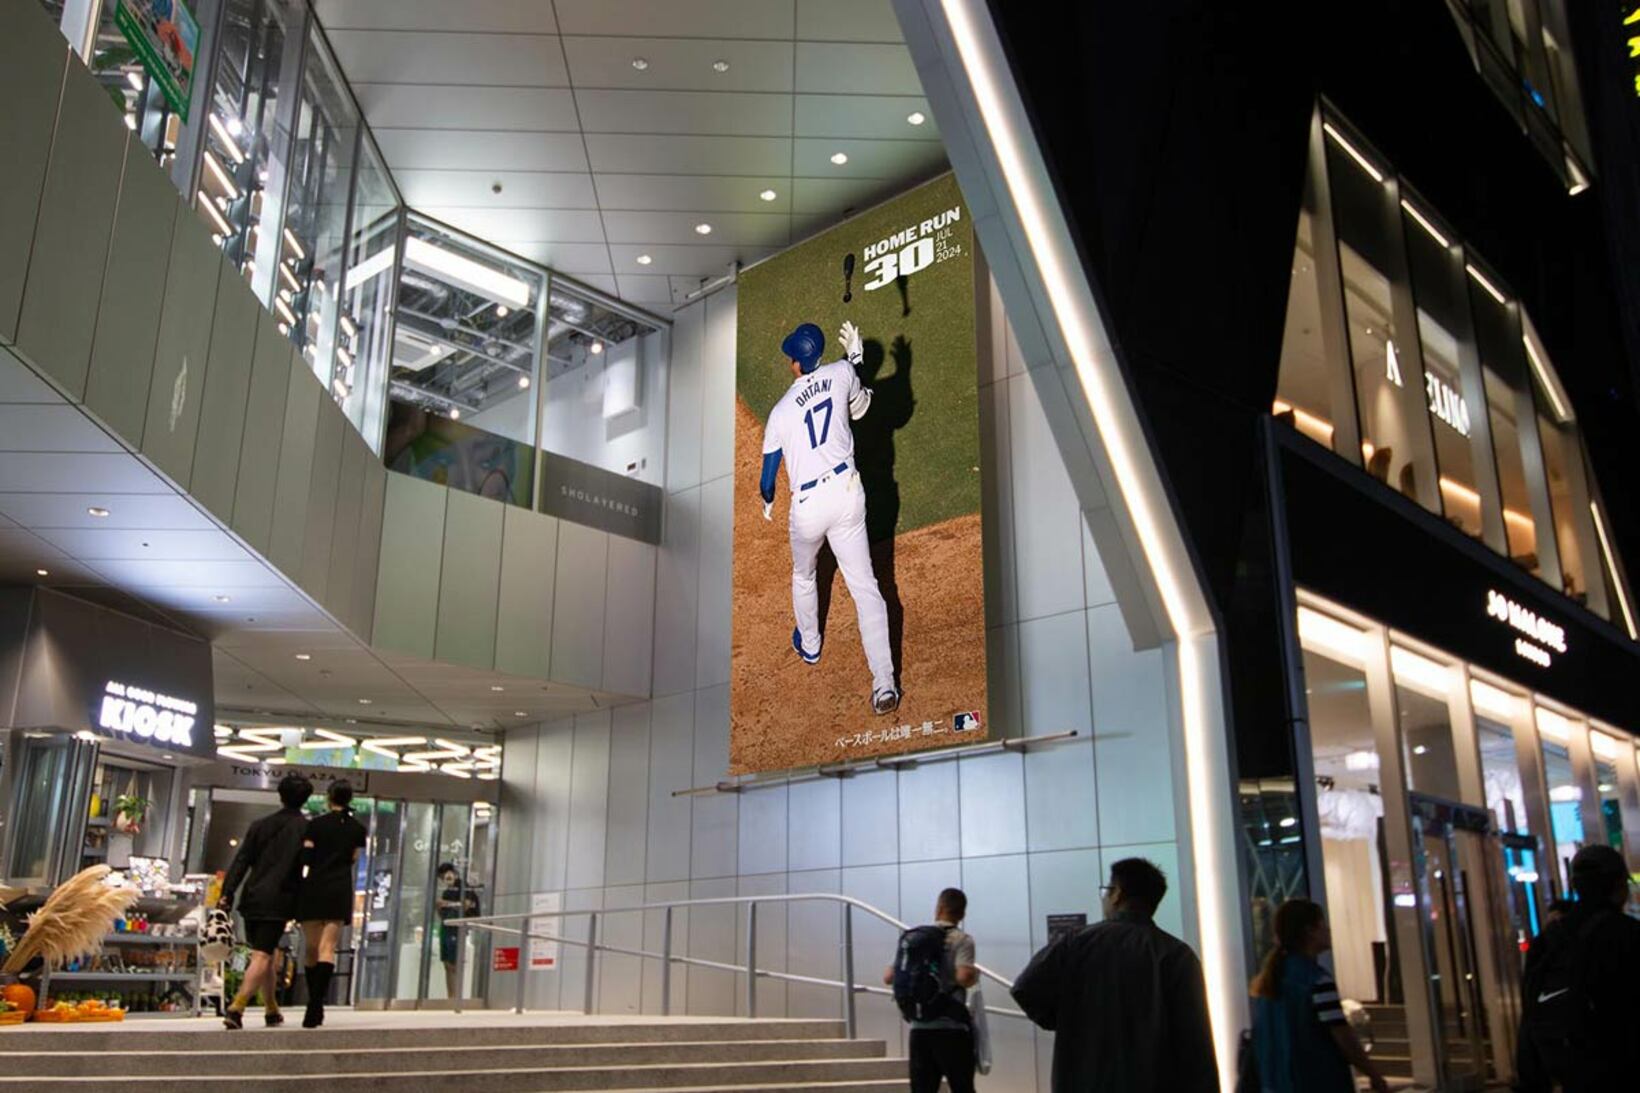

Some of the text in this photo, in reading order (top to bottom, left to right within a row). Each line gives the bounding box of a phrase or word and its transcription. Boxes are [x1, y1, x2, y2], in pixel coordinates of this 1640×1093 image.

[864, 206, 961, 262] HOME RUN
[935, 227, 953, 242] JUL
[935, 240, 948, 253] 21
[864, 237, 935, 291] 30
[935, 244, 962, 264] 2024
[795, 378, 833, 408] OHTANI
[803, 396, 834, 450] 17
[560, 484, 639, 518] SHOLAYERED
[99, 695, 196, 748] KIOSK
[231, 764, 282, 778] TOKYU
